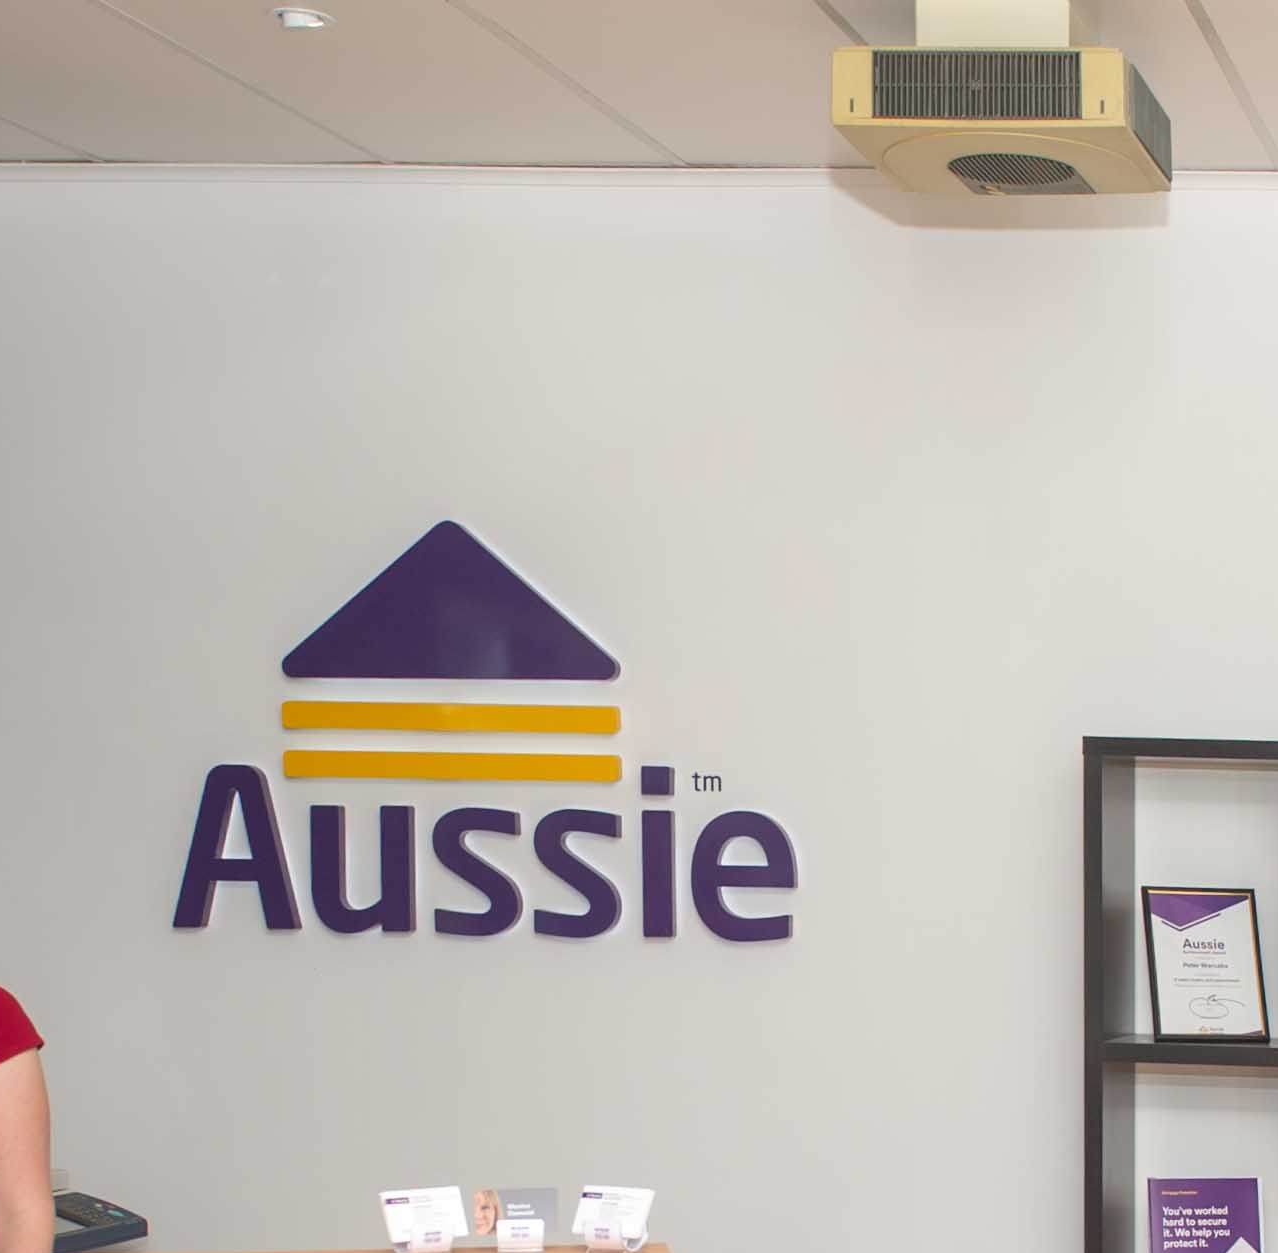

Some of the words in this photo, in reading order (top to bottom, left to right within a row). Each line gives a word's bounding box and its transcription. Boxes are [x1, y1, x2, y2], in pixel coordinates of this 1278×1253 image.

[173, 763, 798, 942] Aussie
[1182, 938, 1226, 950] Aussie
[1162, 1207, 1193, 1216] You've
[1194, 1206, 1229, 1216] worked
[1162, 1217, 1184, 1227] hard
[1186, 1218, 1196, 1227] to
[1197, 1218, 1227, 1226] secure
[1163, 1228, 1173, 1238] it.
[1174, 1228, 1190, 1237] We
[1192, 1227, 1212, 1239] help
[1214, 1229, 1231, 1239] you
[1163, 1239, 1197, 1250] protect
[1198, 1238, 1209, 1248] it.
